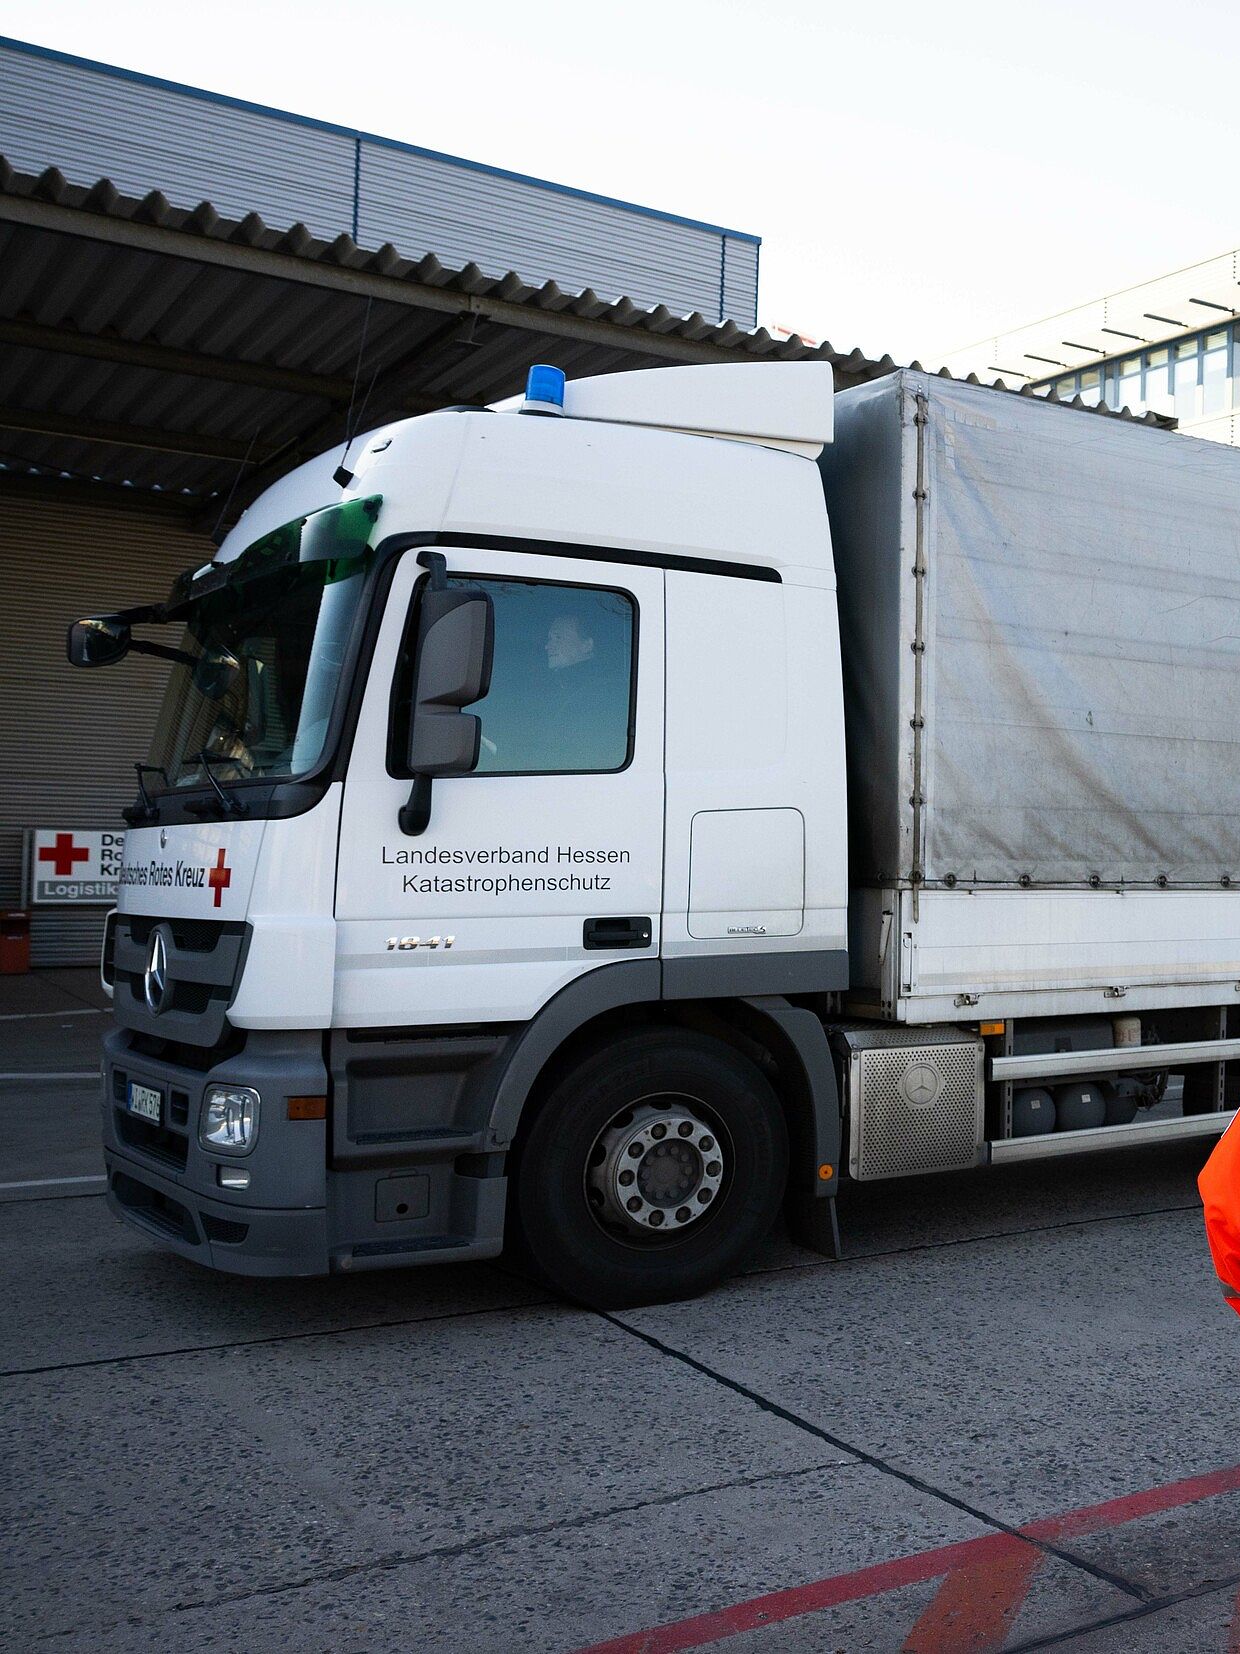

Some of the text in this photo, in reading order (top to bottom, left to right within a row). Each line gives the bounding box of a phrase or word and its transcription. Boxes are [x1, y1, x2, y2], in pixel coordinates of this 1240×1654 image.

[101, 834, 124, 847] De
[382, 846, 630, 865] Landesverband Hessen
[149, 860, 173, 887] Rotes
[175, 860, 205, 888] Kreuz
[402, 873, 611, 896] Katastrophenschutz
[385, 935, 456, 951] 1841
